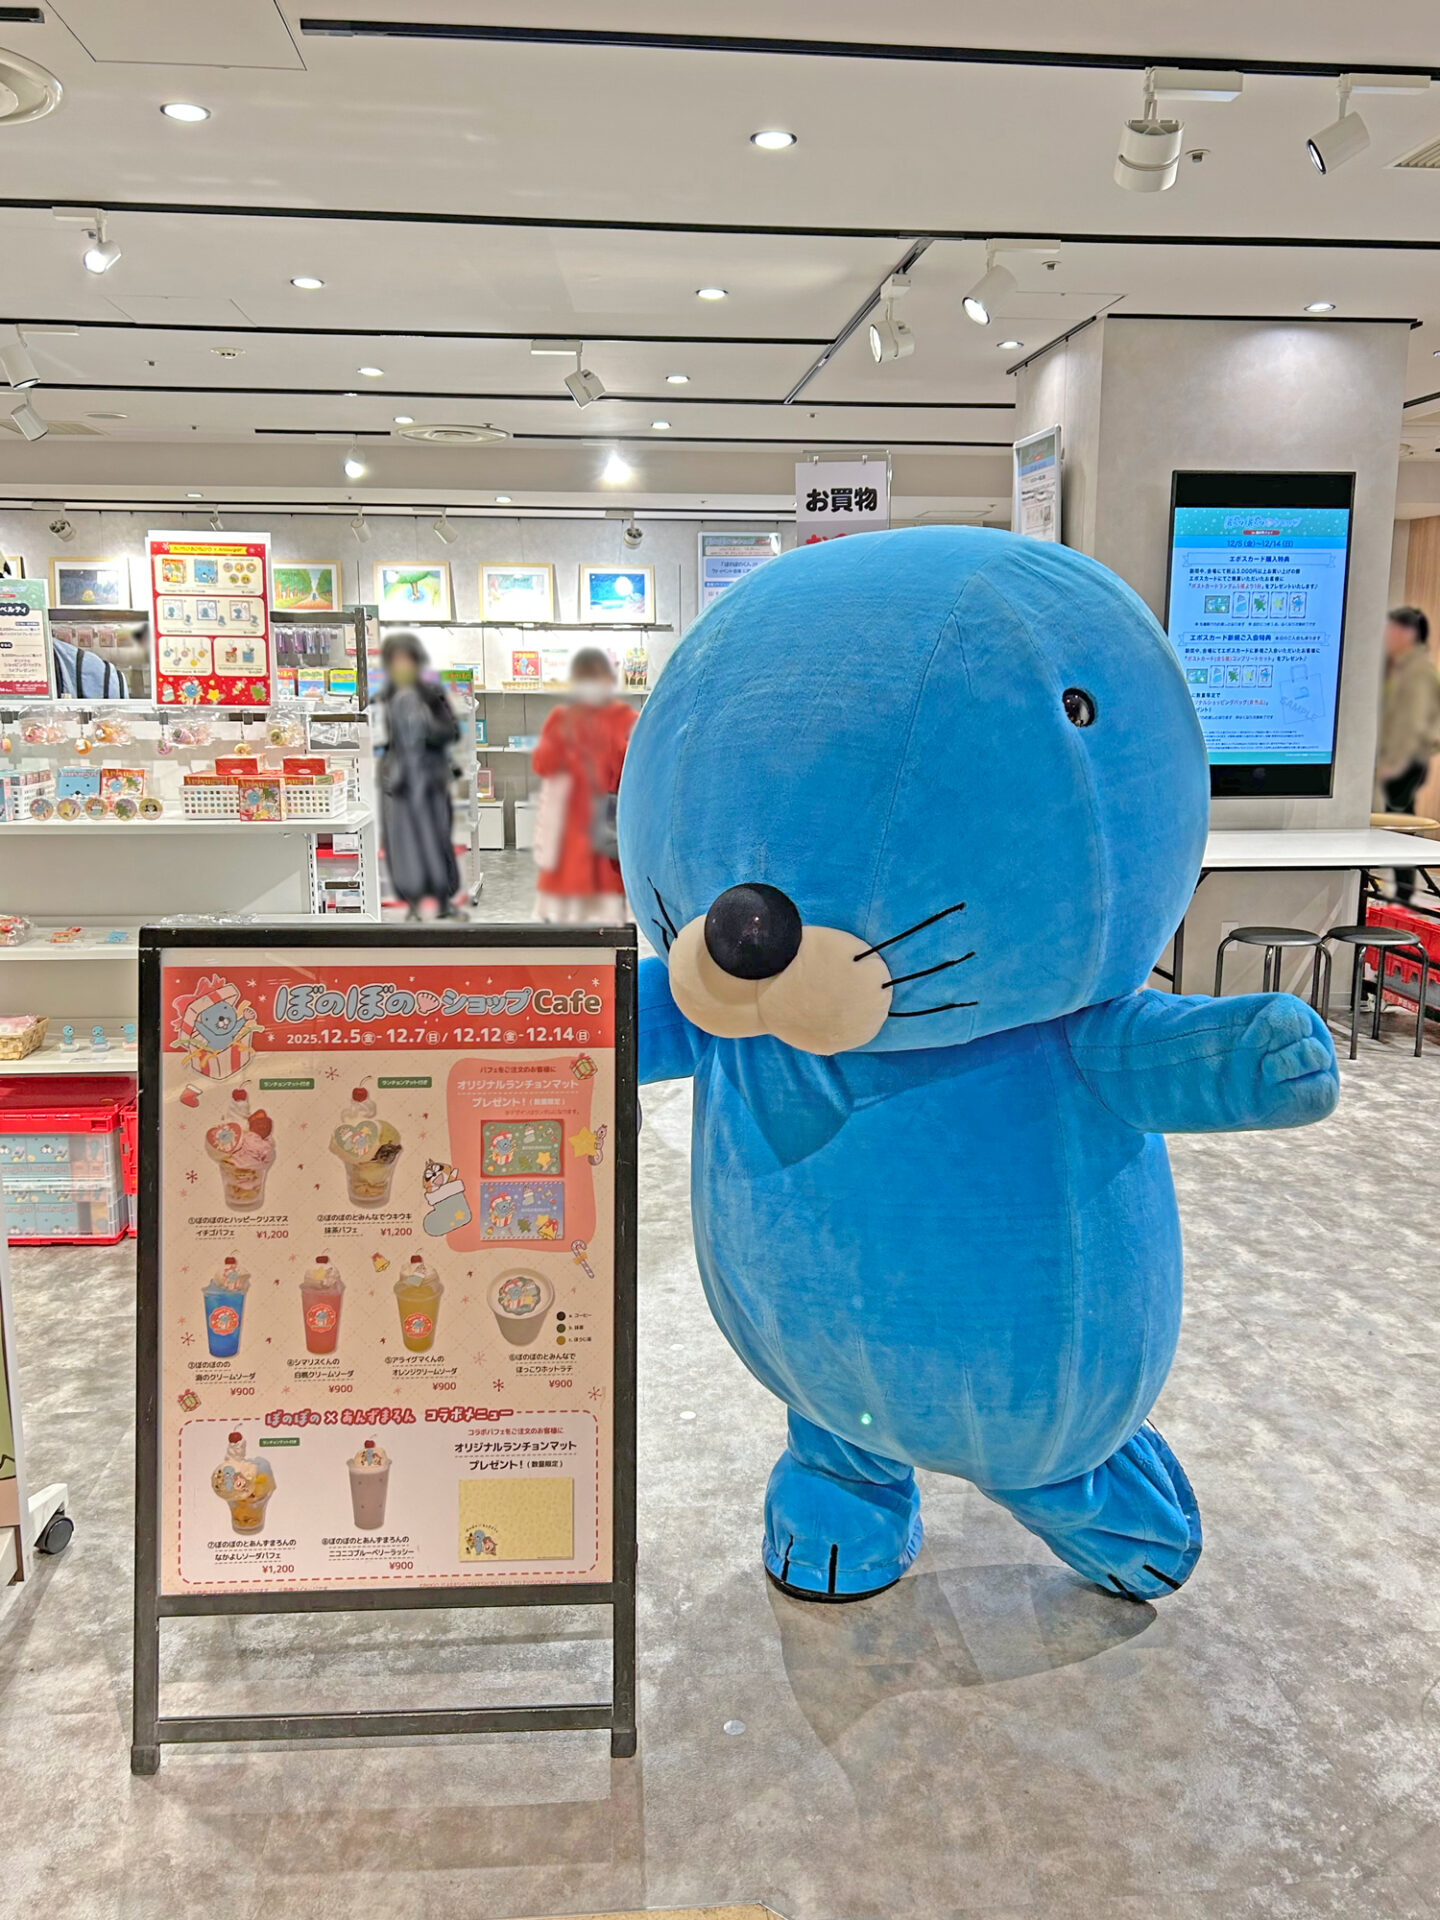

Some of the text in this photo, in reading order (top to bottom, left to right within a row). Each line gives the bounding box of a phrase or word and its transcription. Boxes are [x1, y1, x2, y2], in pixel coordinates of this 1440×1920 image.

[806, 488, 878, 512] お買物
[274, 984, 601, 1021] ぼのぼの ショップ Cafe
[456, 1079, 579, 1091] オリジナルランチョンマット
[188, 1214, 289, 1225] ①ぼのぼのとハッピークリスマス
[196, 1228, 289, 1240] イチゴパフェ ¥1,200
[324, 1226, 413, 1238] 抹茶パフェ ¥1,200
[392, 1367, 458, 1376] オレンジクリームソーダ
[516, 1365, 573, 1374] ほっこりホットラテ
[195, 1372, 256, 1381] 海のクリームソーダ
[432, 1382, 457, 1391] ¥900
[549, 1380, 573, 1388] ¥900
[230, 1387, 255, 1396] ¥900
[328, 1385, 353, 1393] ¥900
[265, 1409, 321, 1428] ぼのぼの
[340, 1407, 416, 1426] あんずまろん
[425, 1406, 514, 1423] コラボメニュー
[468, 1427, 564, 1436] コラボパフェをご注文のお客様に
[454, 1441, 577, 1453] オリジナルランチョンマット
[215, 1552, 281, 1561] なかよしソーダパフェ
[328, 1548, 415, 1558] ニコニコブルーベリーラッシー
[262, 1564, 294, 1574] ¥1,200
[389, 1561, 414, 1570] ¥900
